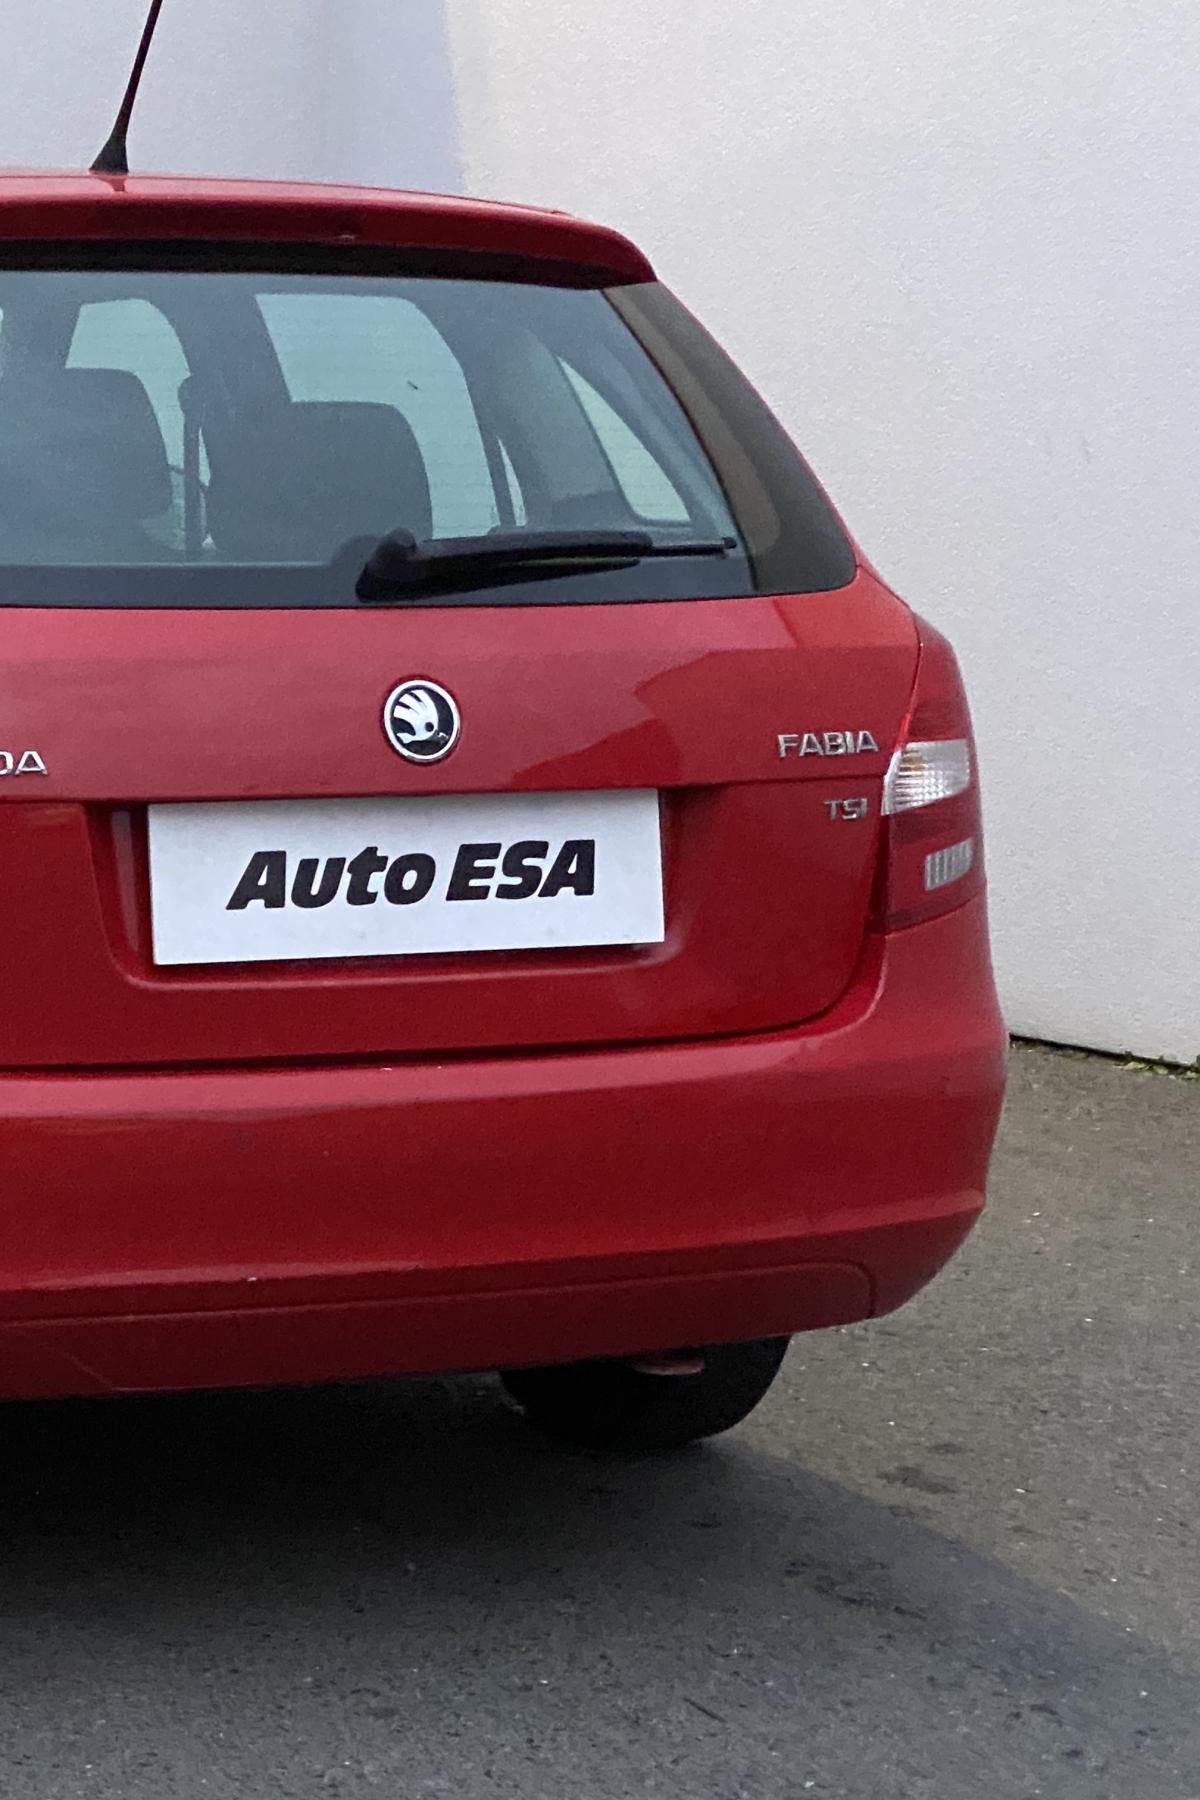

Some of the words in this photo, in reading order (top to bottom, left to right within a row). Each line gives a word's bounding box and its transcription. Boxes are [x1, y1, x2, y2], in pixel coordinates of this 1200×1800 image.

[777, 730, 879, 758] FABIA
[824, 798, 868, 820] TSI
[225, 846, 436, 911] Auto
[446, 839, 596, 902] ESA
